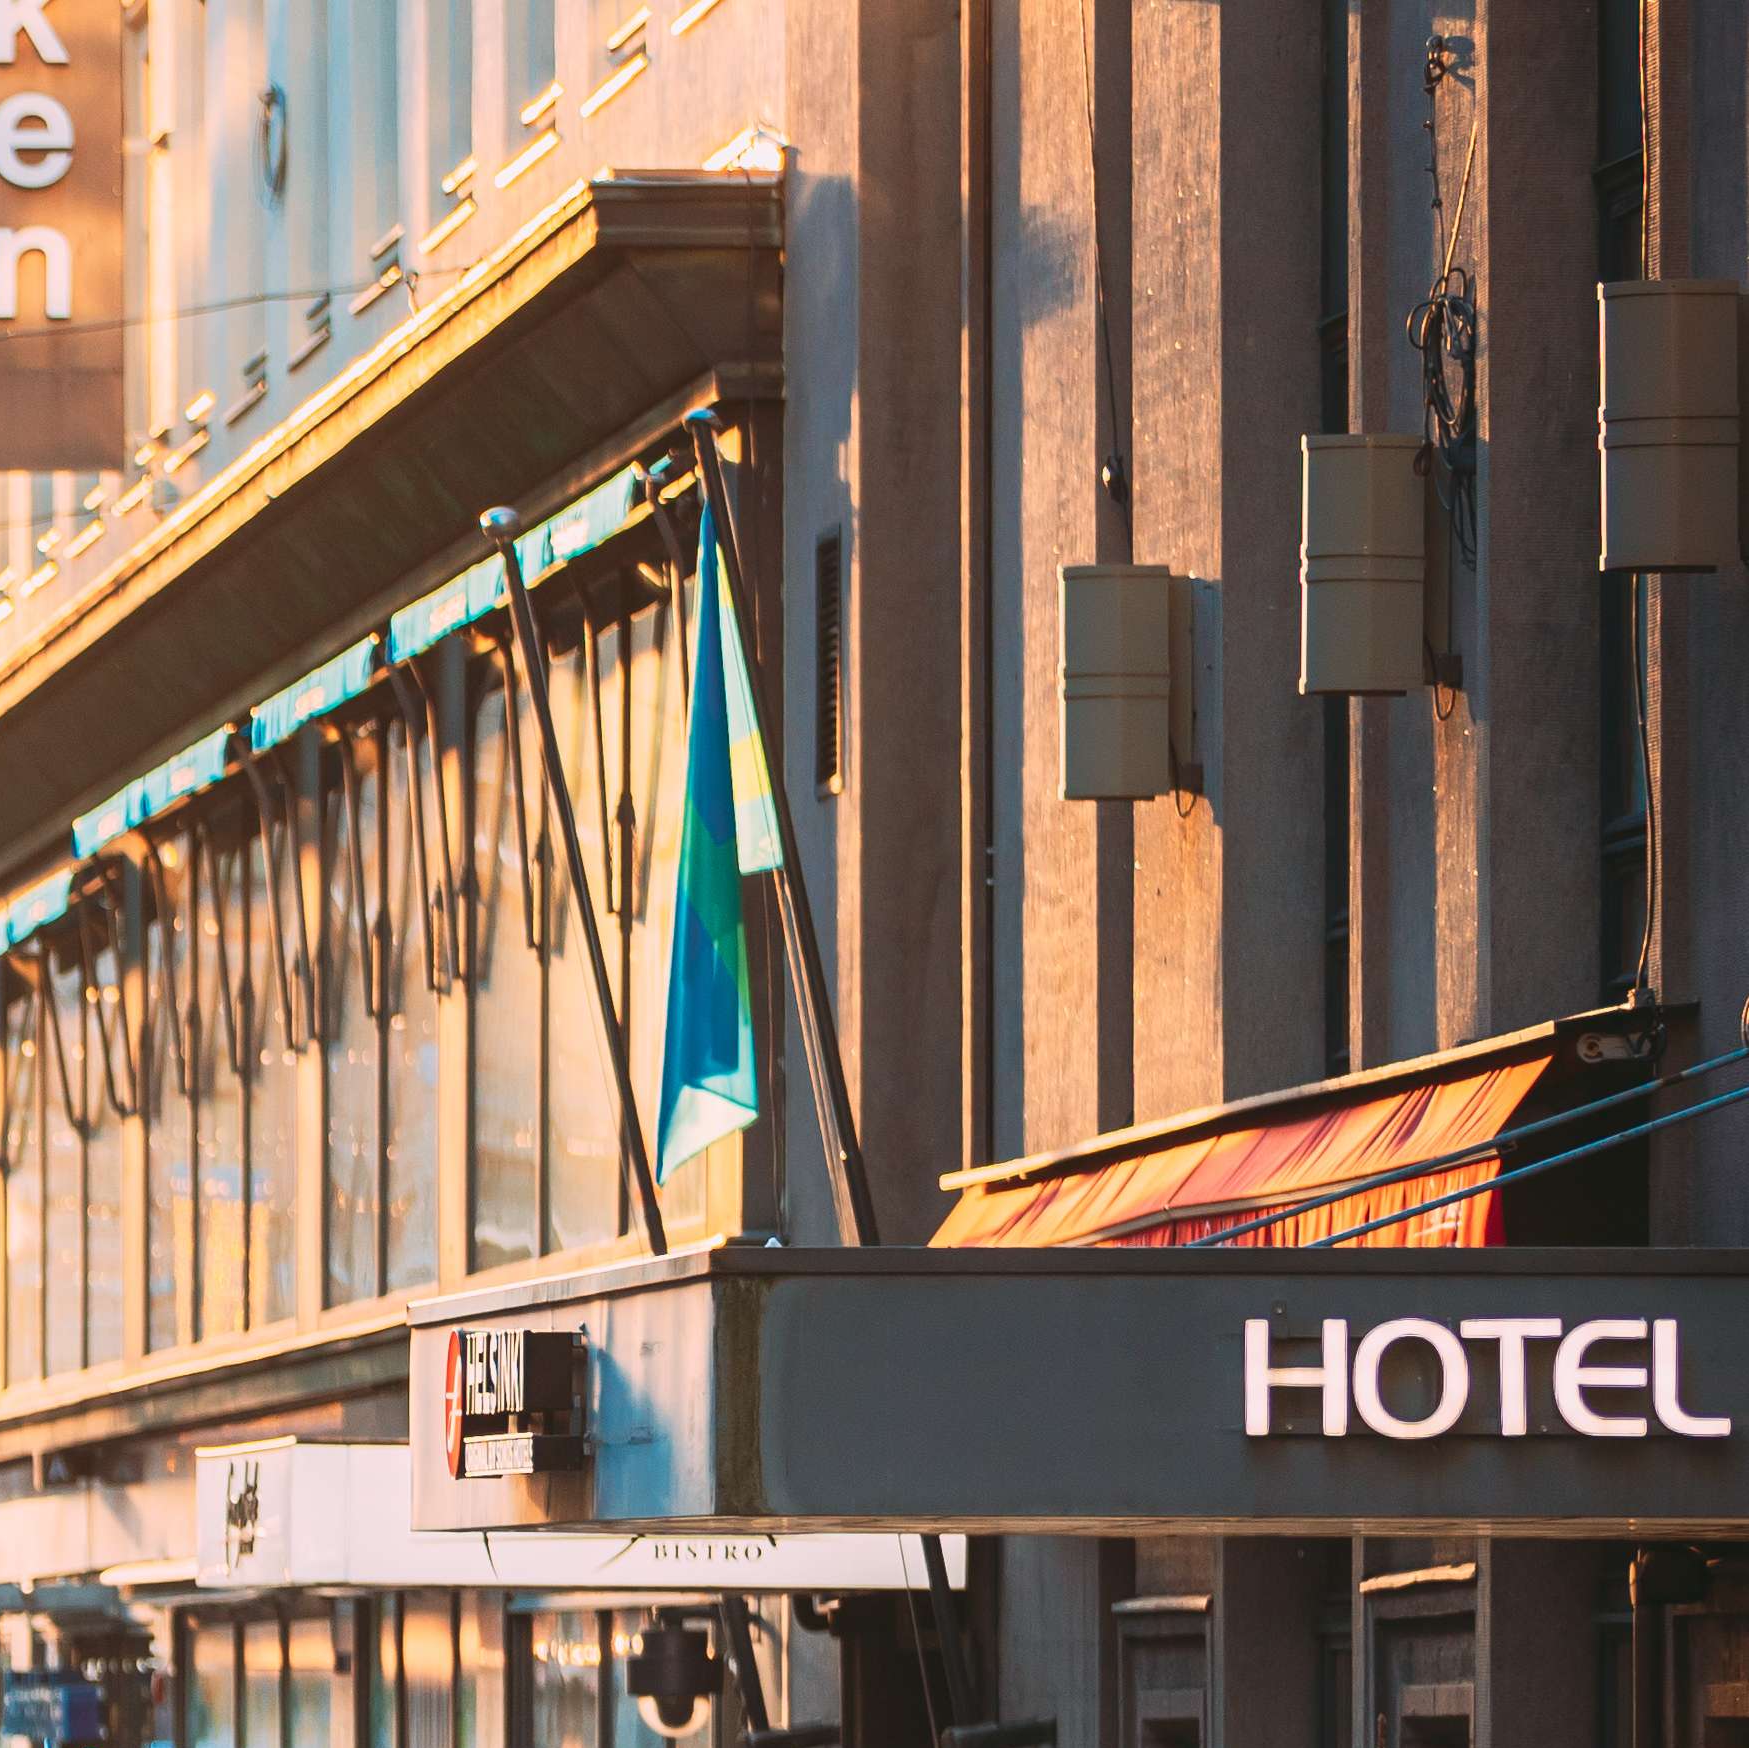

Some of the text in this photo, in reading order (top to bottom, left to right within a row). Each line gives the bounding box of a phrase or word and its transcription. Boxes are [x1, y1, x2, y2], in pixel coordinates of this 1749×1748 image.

[465, 1329, 524, 1415] HELSINKI
[1244, 1318, 1731, 1438] HOTEL
[655, 1544, 762, 1560] BISTRO
